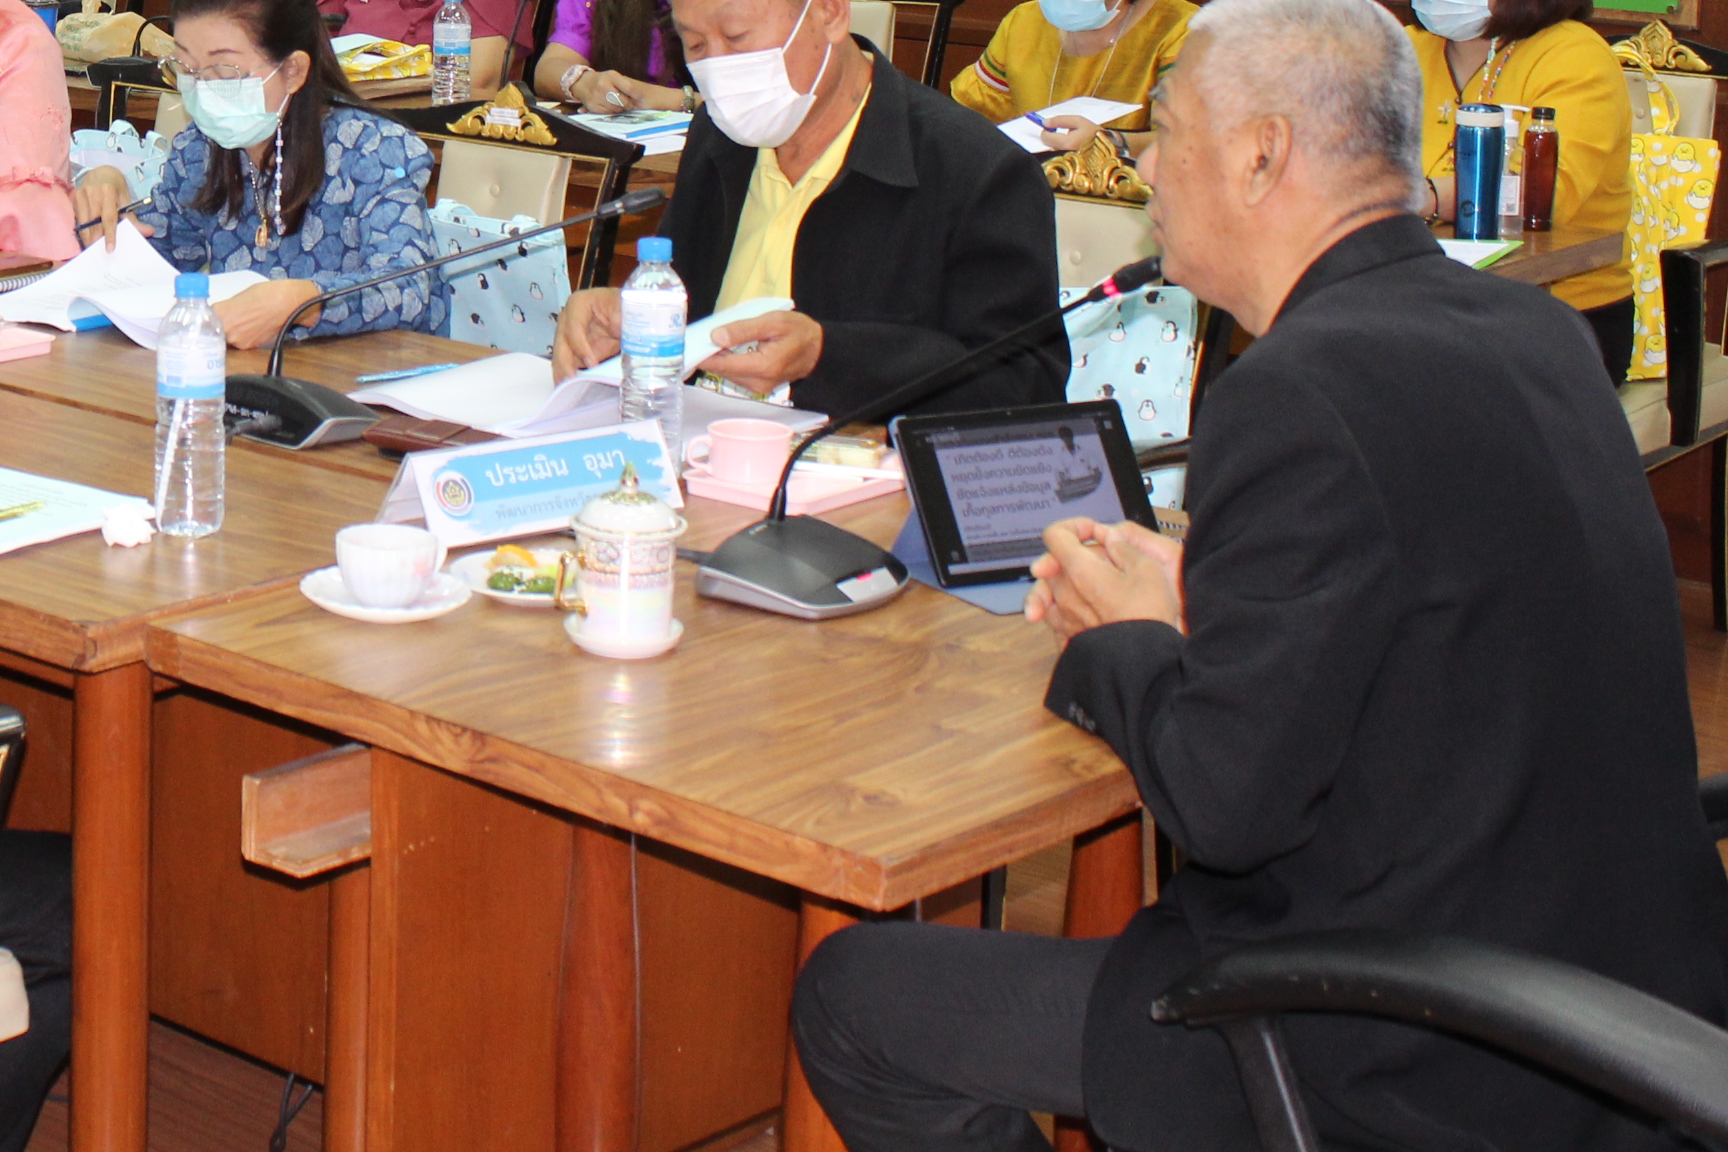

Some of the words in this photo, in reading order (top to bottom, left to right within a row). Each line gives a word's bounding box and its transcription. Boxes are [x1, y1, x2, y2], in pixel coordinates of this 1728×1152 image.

[485, 454, 569, 487] ประเมิน
[582, 450, 627, 479] อุมา
